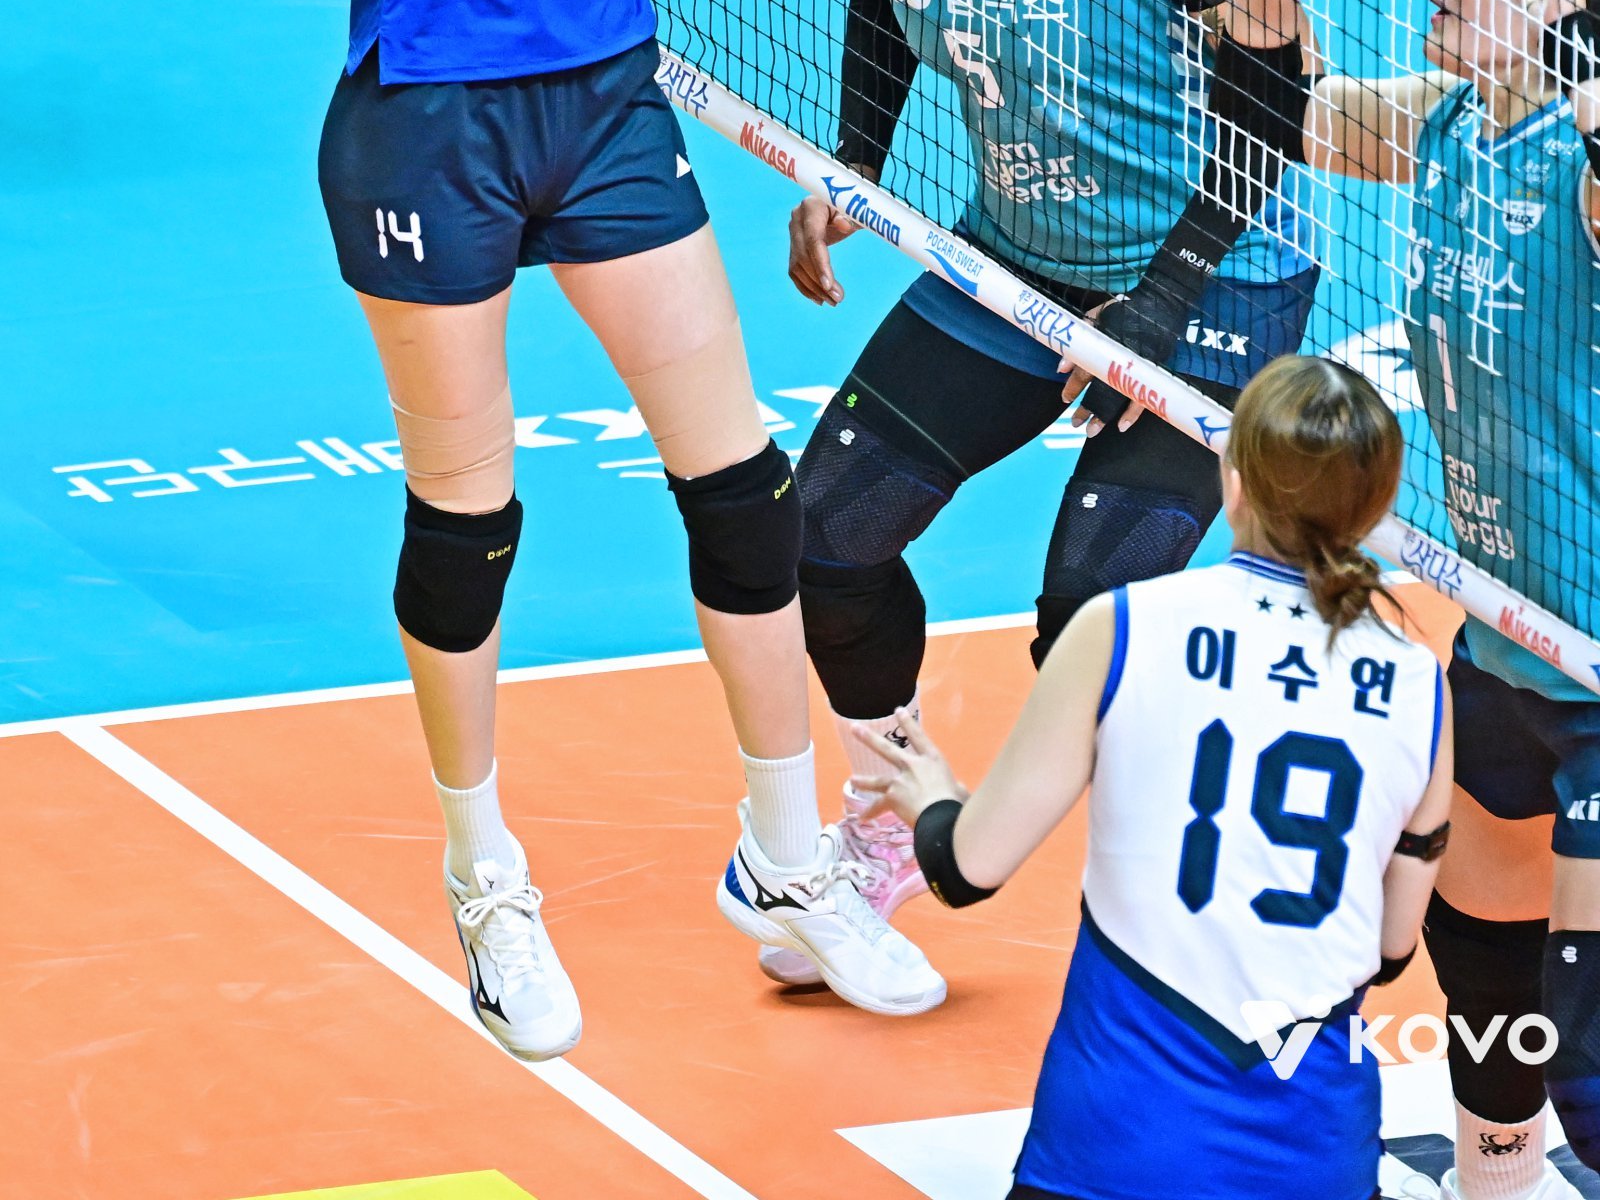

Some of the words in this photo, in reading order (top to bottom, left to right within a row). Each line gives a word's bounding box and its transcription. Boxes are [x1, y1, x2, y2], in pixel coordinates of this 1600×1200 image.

[943, 28, 1005, 109] 5
[375, 207, 424, 262] 14
[926, 230, 957, 260] POCARI
[954, 250, 984, 278] SWEAT
[1177, 318, 1250, 356] ixx
[1177, 718, 1364, 930] 19
